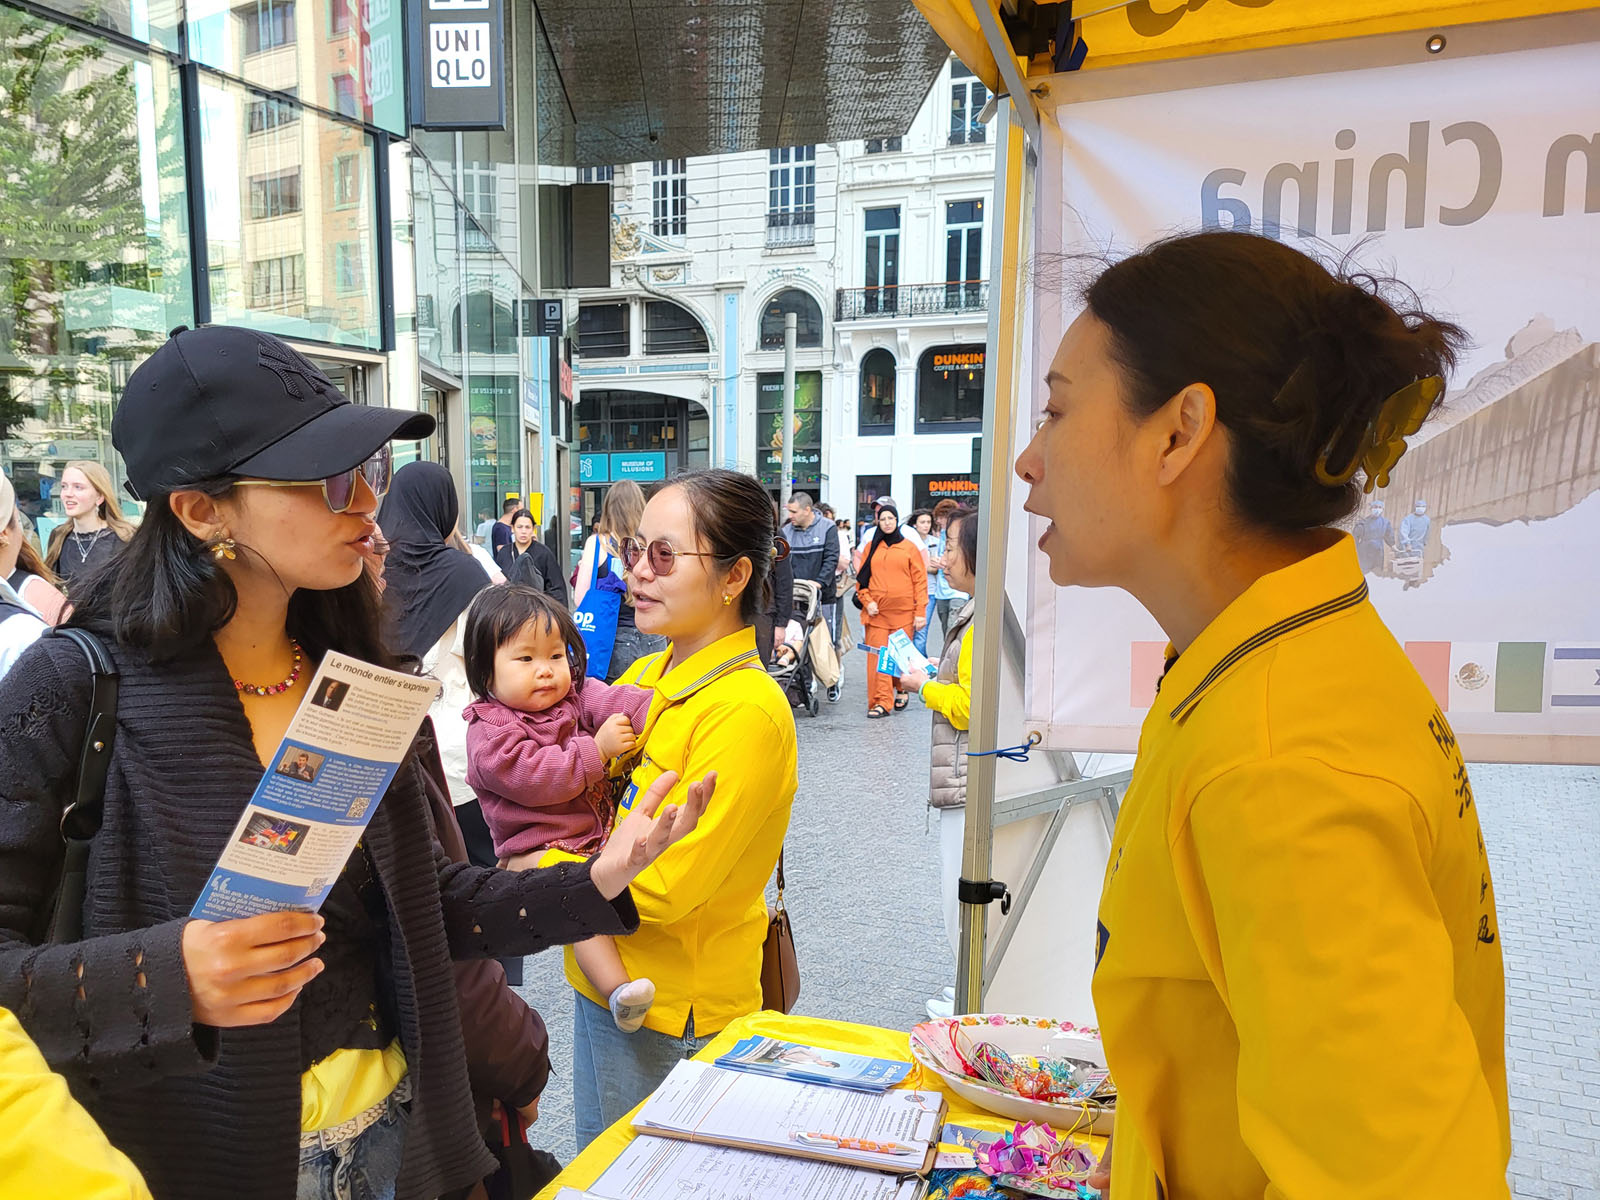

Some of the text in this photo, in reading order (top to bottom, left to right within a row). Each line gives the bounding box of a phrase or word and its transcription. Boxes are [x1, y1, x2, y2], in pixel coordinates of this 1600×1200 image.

[436, 30, 480, 52] UNI
[436, 59, 485, 85] QLO
[549, 306, 556, 317] P
[329, 657, 343, 670] Le
[342, 663, 374, 680] monde
[373, 672, 399, 688] entier
